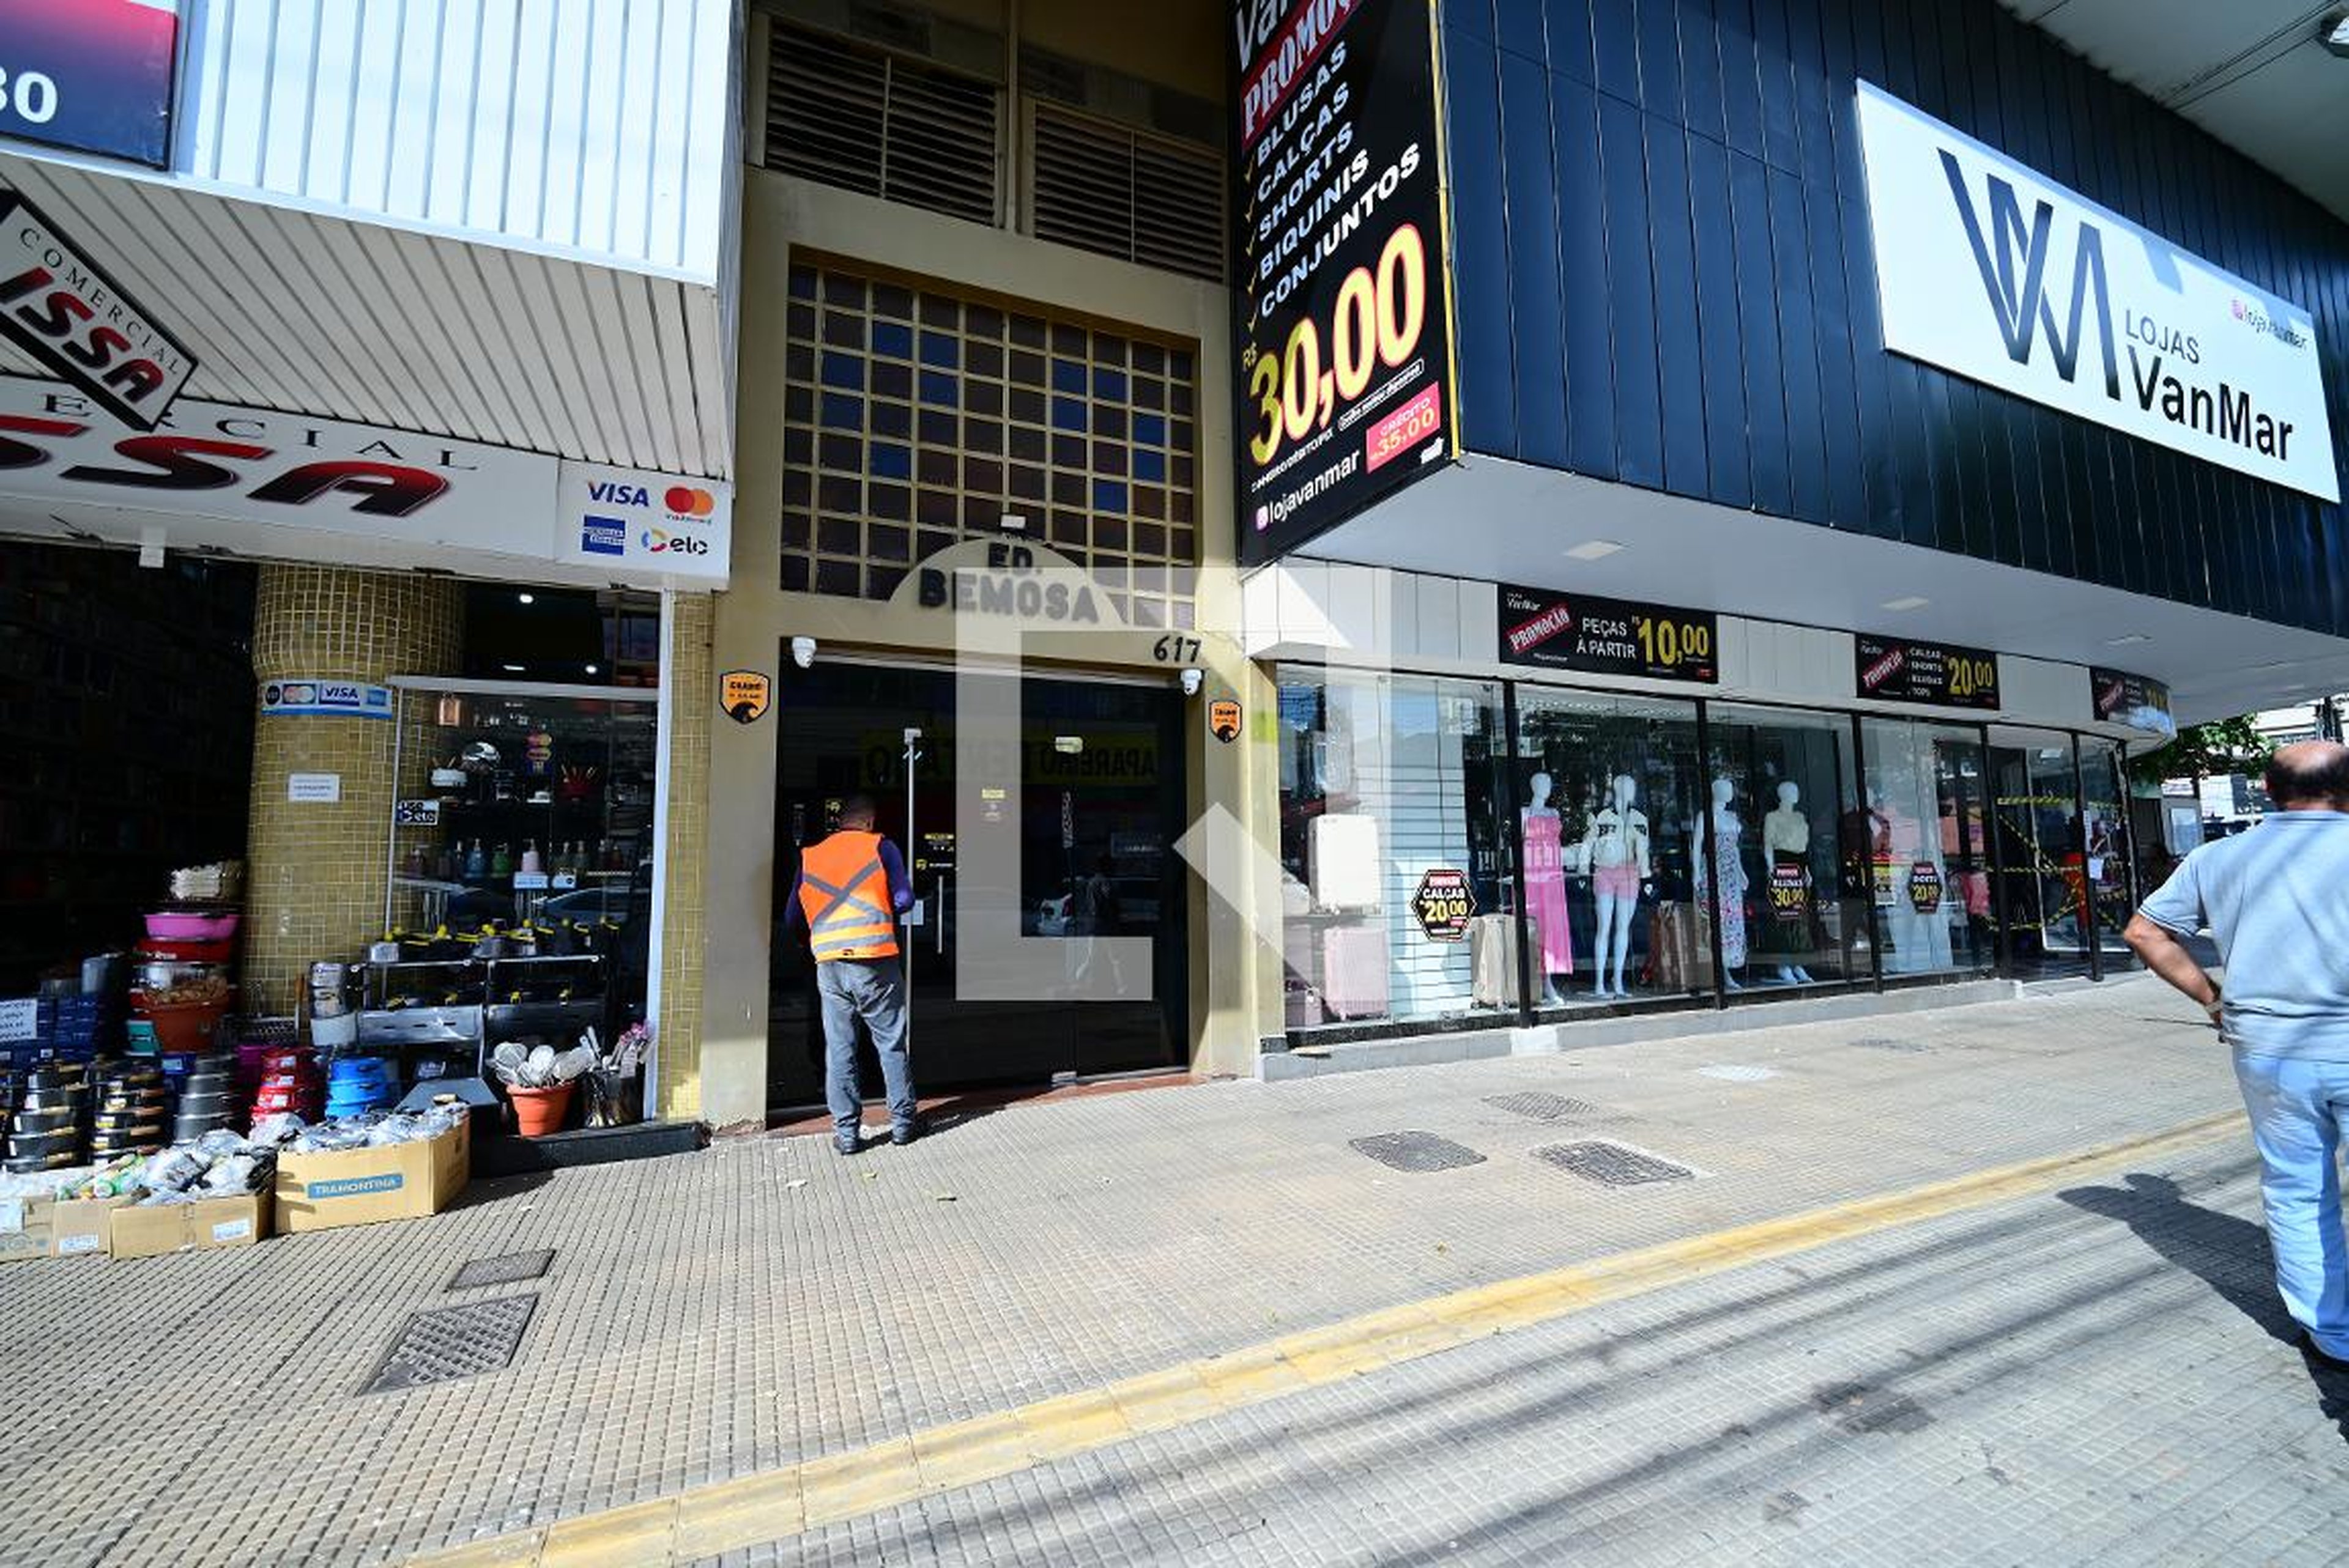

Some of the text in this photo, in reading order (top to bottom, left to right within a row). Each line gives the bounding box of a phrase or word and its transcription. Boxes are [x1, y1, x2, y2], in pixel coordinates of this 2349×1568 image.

[0, 67, 58, 123] 0
[1244, 0, 1351, 139] PROMO
[1258, 41, 1346, 166] BLUSAS
[1258, 82, 1349, 202] CALÇAS
[1259, 122, 1353, 241] SHORTS
[1260, 149, 1369, 280] BIQUINIS
[1261, 142, 1420, 317] CONJUNTOS
[20, 227, 179, 375] COMERCIAL
[0, 266, 164, 404] ISSA
[1250, 223, 1426, 467] 30,00
[2126, 309, 2200, 364] LOJAS
[2128, 345, 2293, 461] VanMar
[588, 479, 649, 507] VISA
[1269, 449, 1360, 524] lojavanmar
[670, 536, 708, 555] elo
[987, 542, 1043, 577] ED.
[919, 567, 1099, 624] BEMOSA
[1153, 635, 1202, 663] 617
[1582, 618, 1627, 638] PEÇAS
[1590, 640, 1636, 659] PARTIR
[1638, 618, 1709, 665] 10,00
[325, 687, 358, 698] VISA
[1423, 888, 1466, 900] CALÇAS
